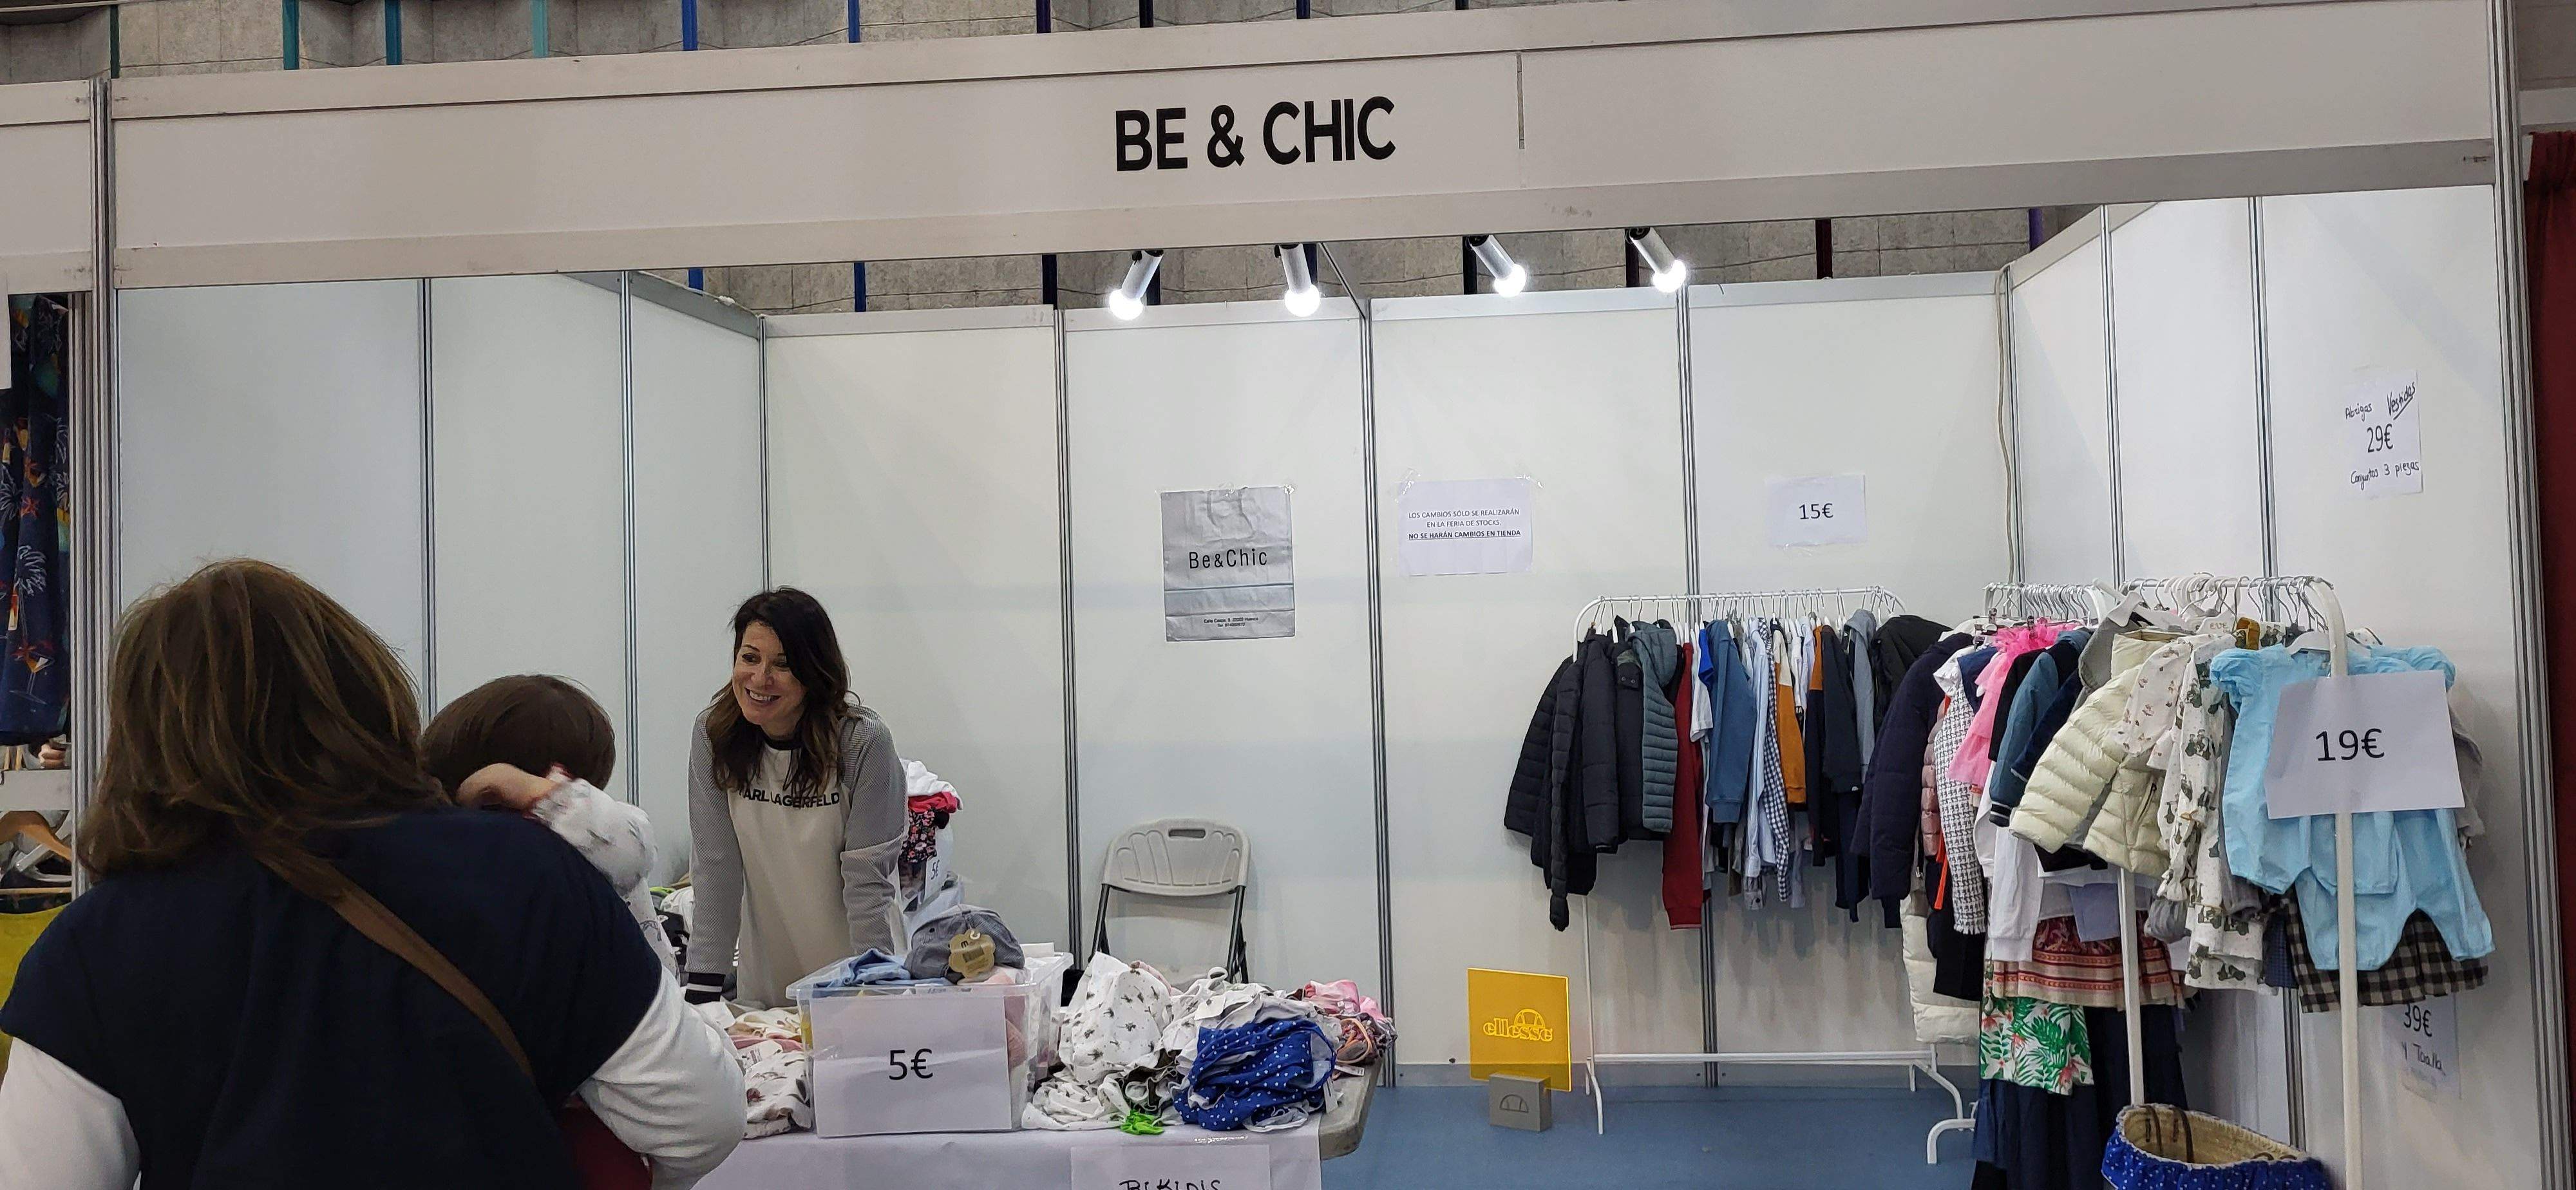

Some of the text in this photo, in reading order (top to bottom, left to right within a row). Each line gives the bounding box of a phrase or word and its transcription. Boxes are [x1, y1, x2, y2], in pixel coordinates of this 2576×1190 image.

[1115, 96, 1397, 172] BE & CHIC
[2387, 381, 2416, 417] Vestidos
[2367, 423, 2394, 453] 29€
[2350, 460, 2420, 491] Conjuntos 3 piezas
[1481, 508, 1520, 516] REALIZARÁN
[1799, 503, 1834, 520] 15€
[1428, 531, 1453, 539] HARÁN
[1189, 548, 1268, 569] Be&Chic
[2315, 727, 2386, 763] 19€
[740, 789, 770, 802] ARL
[1482, 1017, 1553, 1043] ellesse
[2403, 1003, 2432, 1037] 39€
[888, 1048, 934, 1080] 5€
